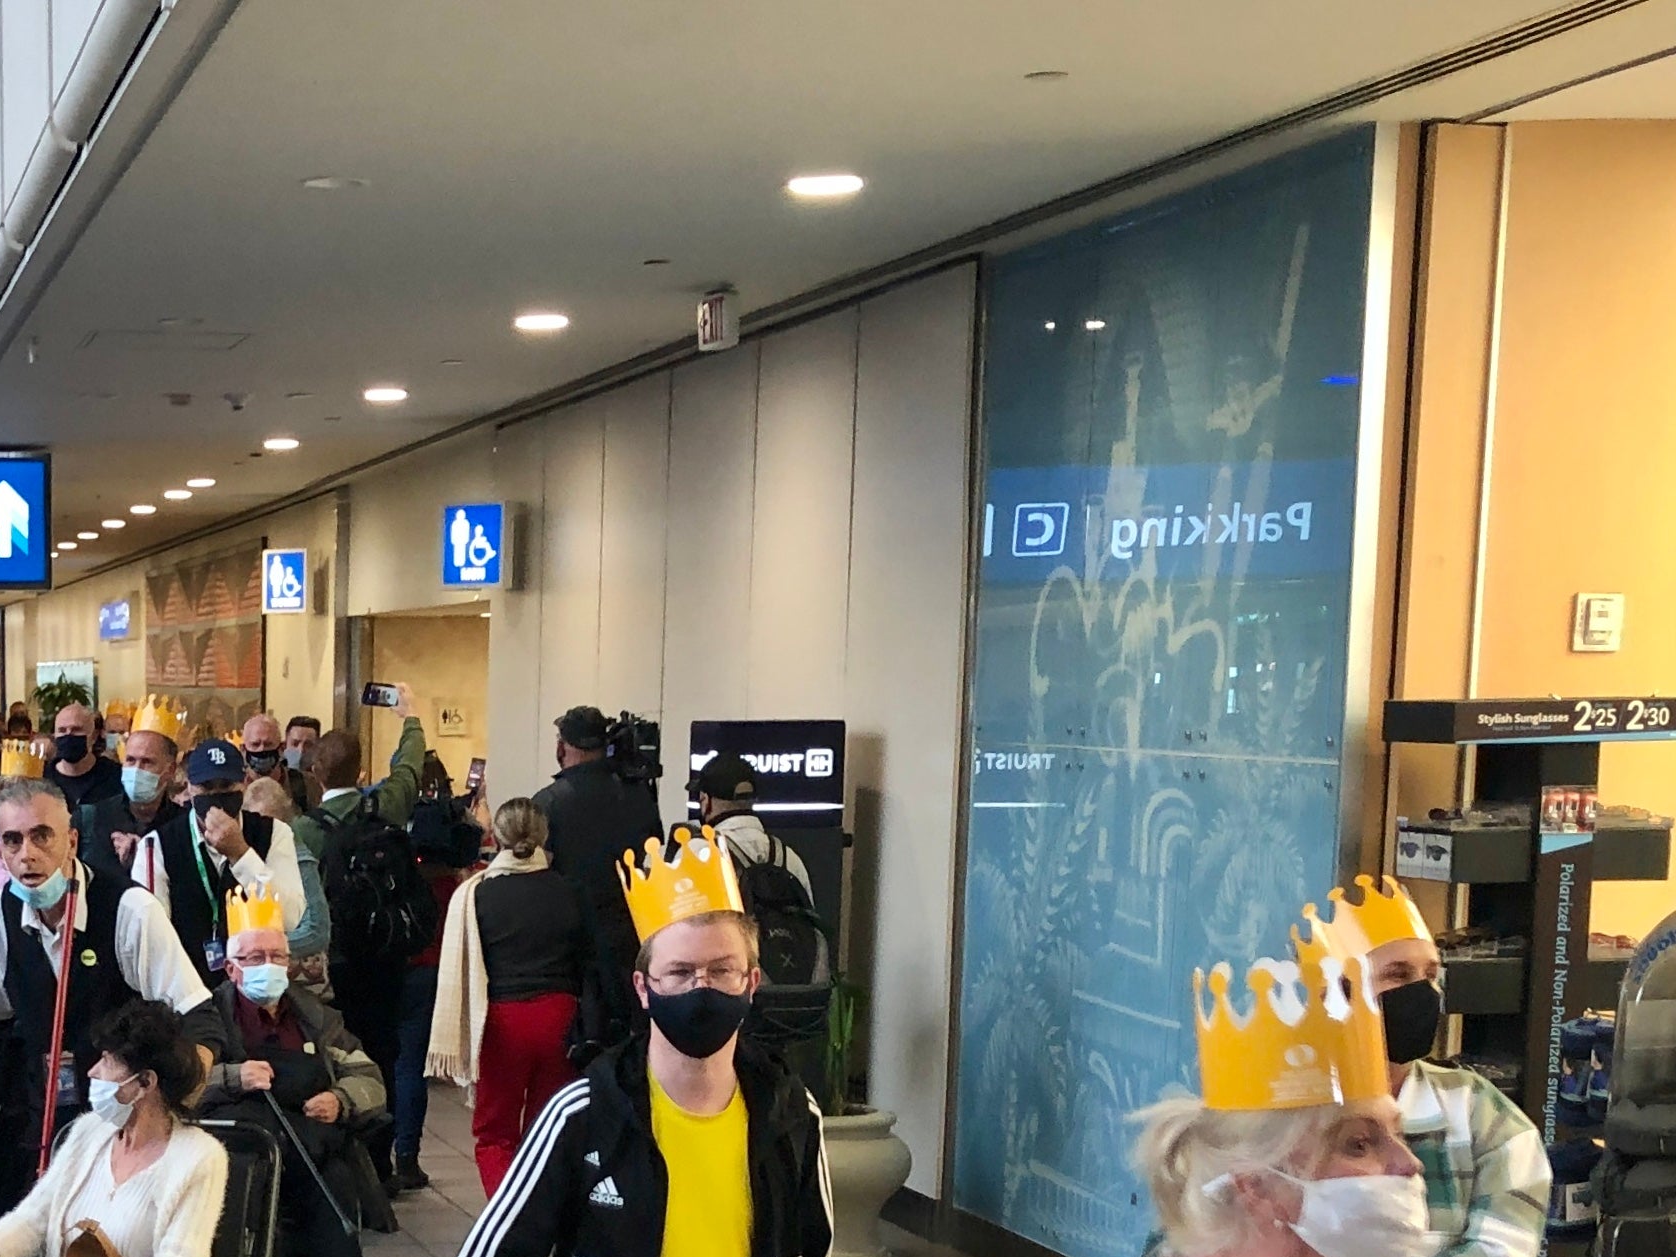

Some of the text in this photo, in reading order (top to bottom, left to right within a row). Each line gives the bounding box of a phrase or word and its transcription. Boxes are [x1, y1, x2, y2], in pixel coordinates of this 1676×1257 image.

[1478, 713, 1512, 726] Stylish
[1514, 712, 1569, 726] Sunglasses
[207, 748, 226, 765] TB
[1542, 863, 1574, 1146] Polarized and Non-Polarized sunglass
[589, 1192, 624, 1206] adidas
